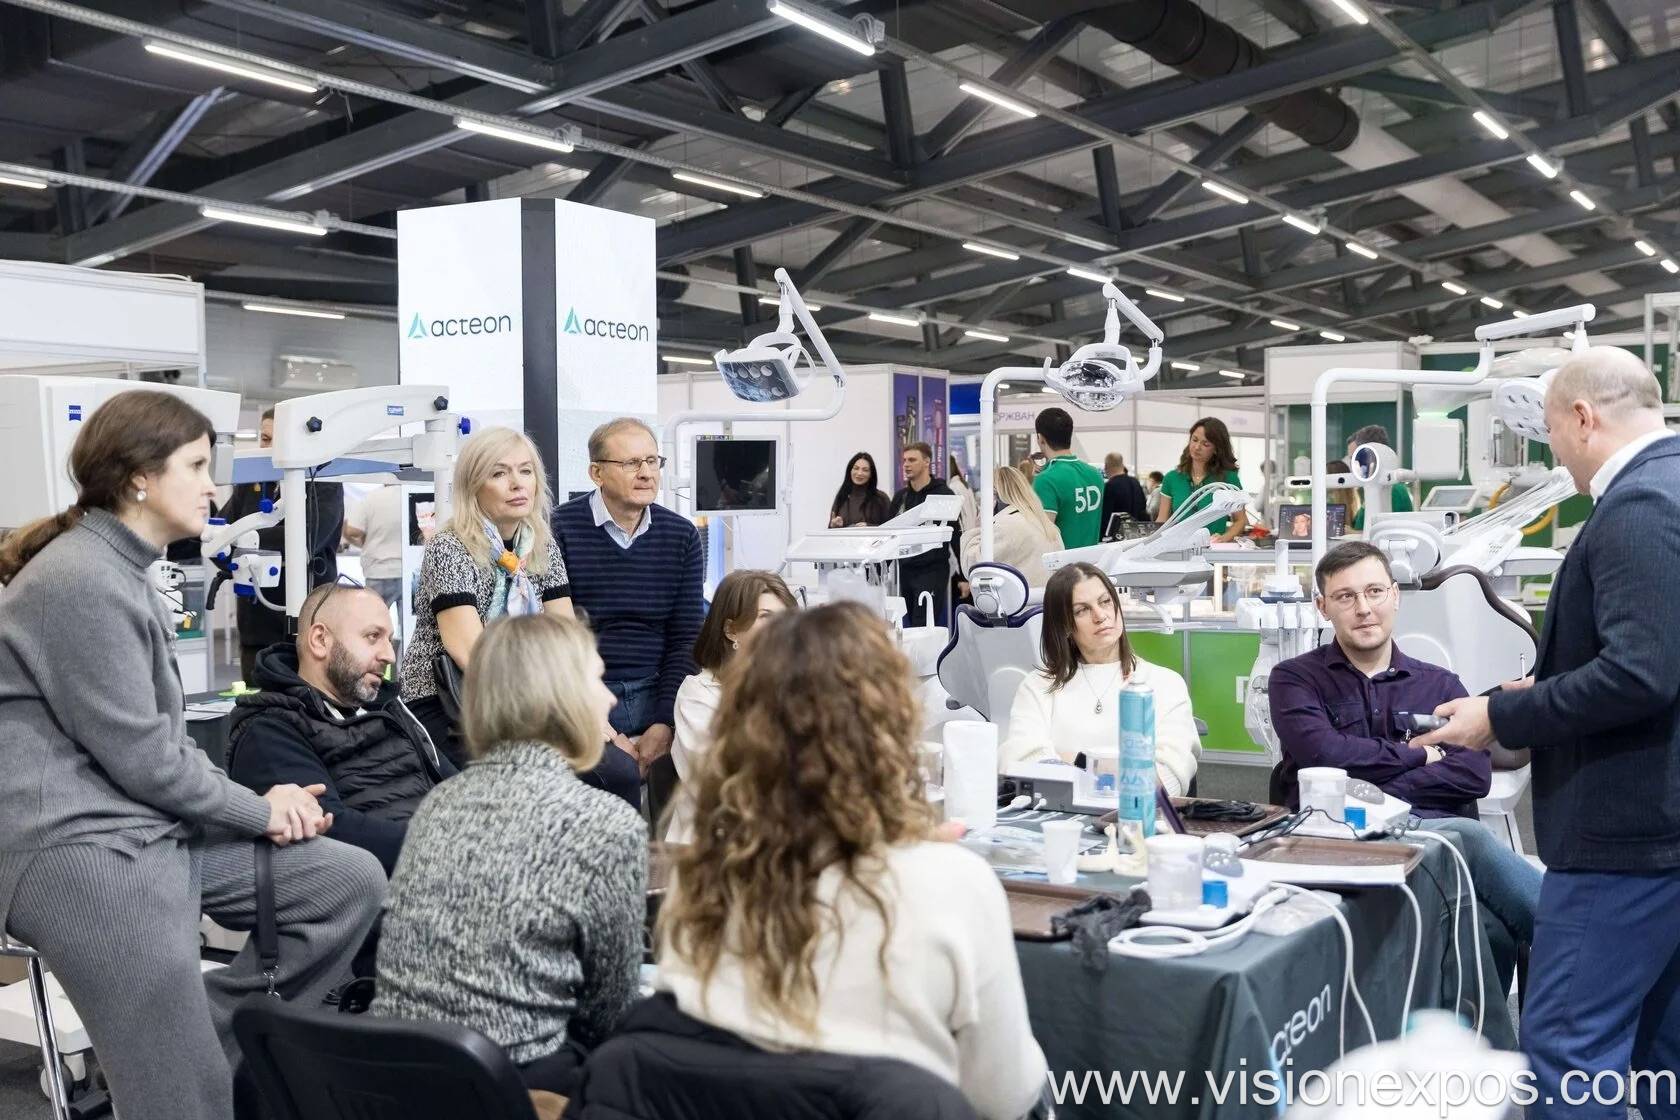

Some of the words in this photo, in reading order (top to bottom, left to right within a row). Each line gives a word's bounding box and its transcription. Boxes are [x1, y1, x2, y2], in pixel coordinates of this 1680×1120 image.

[431, 315, 511, 337] acteon
[584, 318, 649, 342] acteon
[996, 410, 1035, 422] РЖВАН
[1074, 485, 1101, 513] 5D
